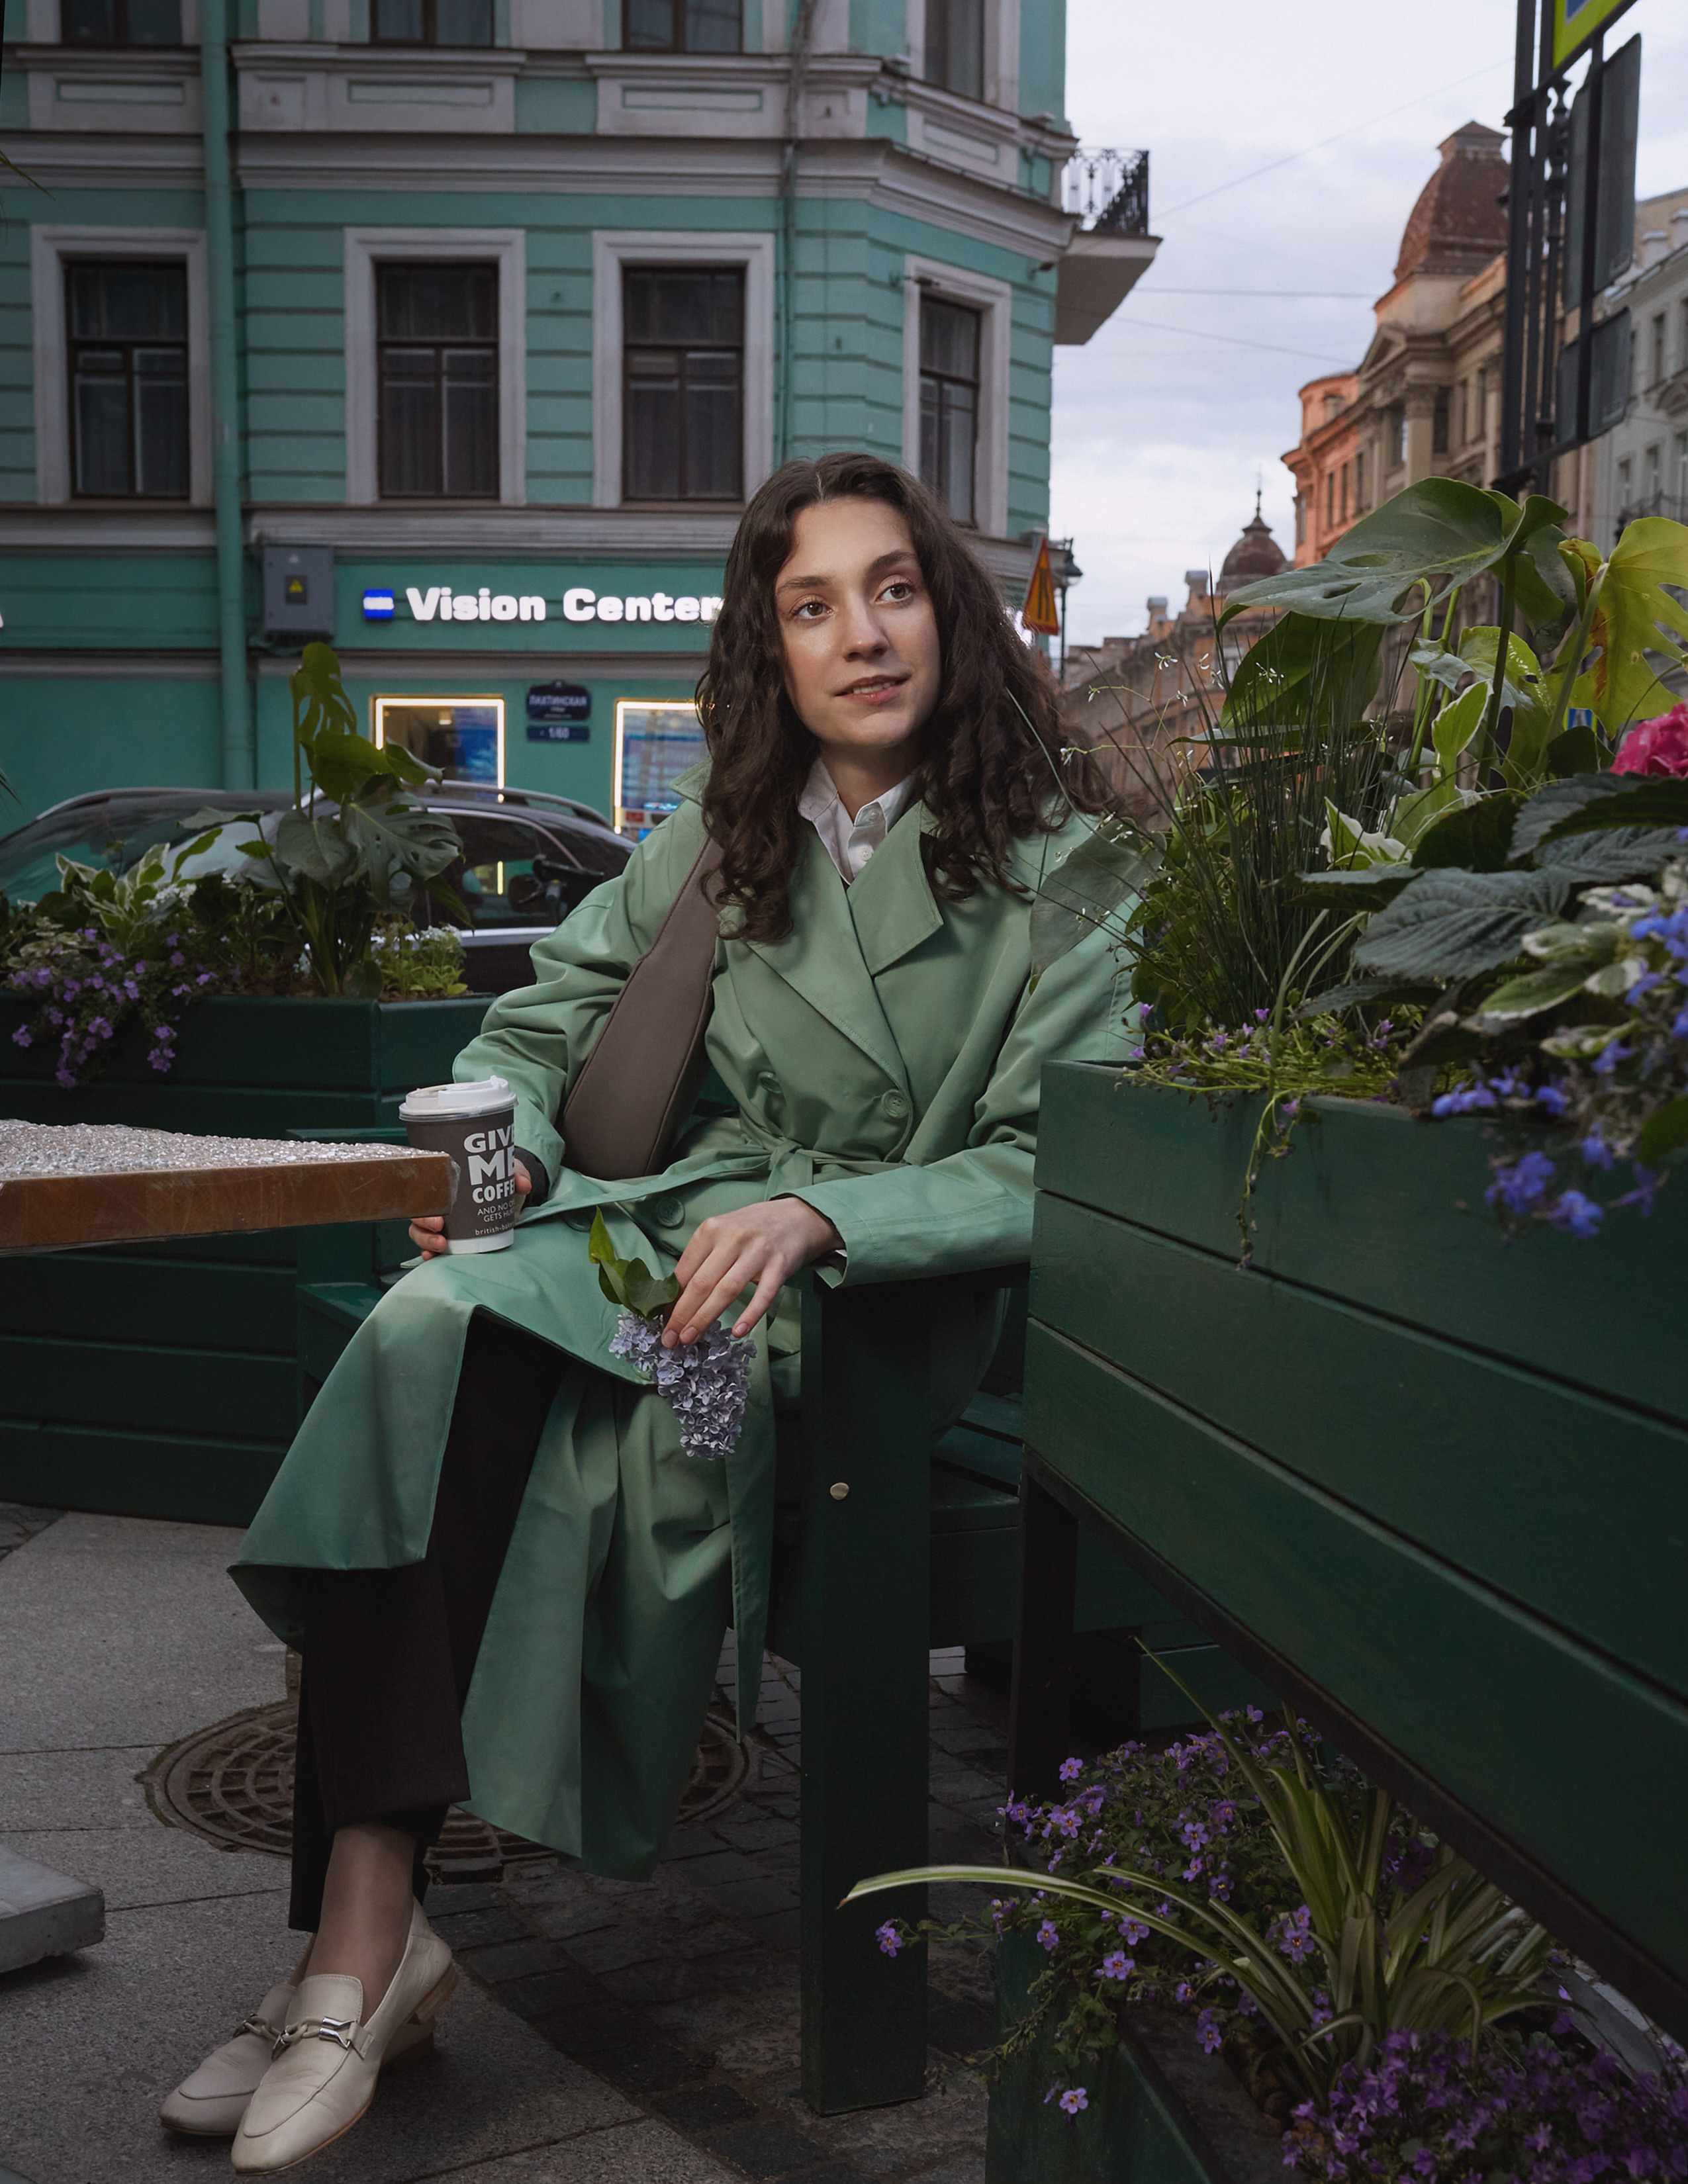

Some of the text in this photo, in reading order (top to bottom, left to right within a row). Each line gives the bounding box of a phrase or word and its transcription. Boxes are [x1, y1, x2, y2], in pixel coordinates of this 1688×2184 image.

[406, 587, 724, 621] Vision Center
[477, 1206, 496, 1216] AND
[498, 1202, 508, 1212] NO
[483, 1212, 502, 1222] GETS
